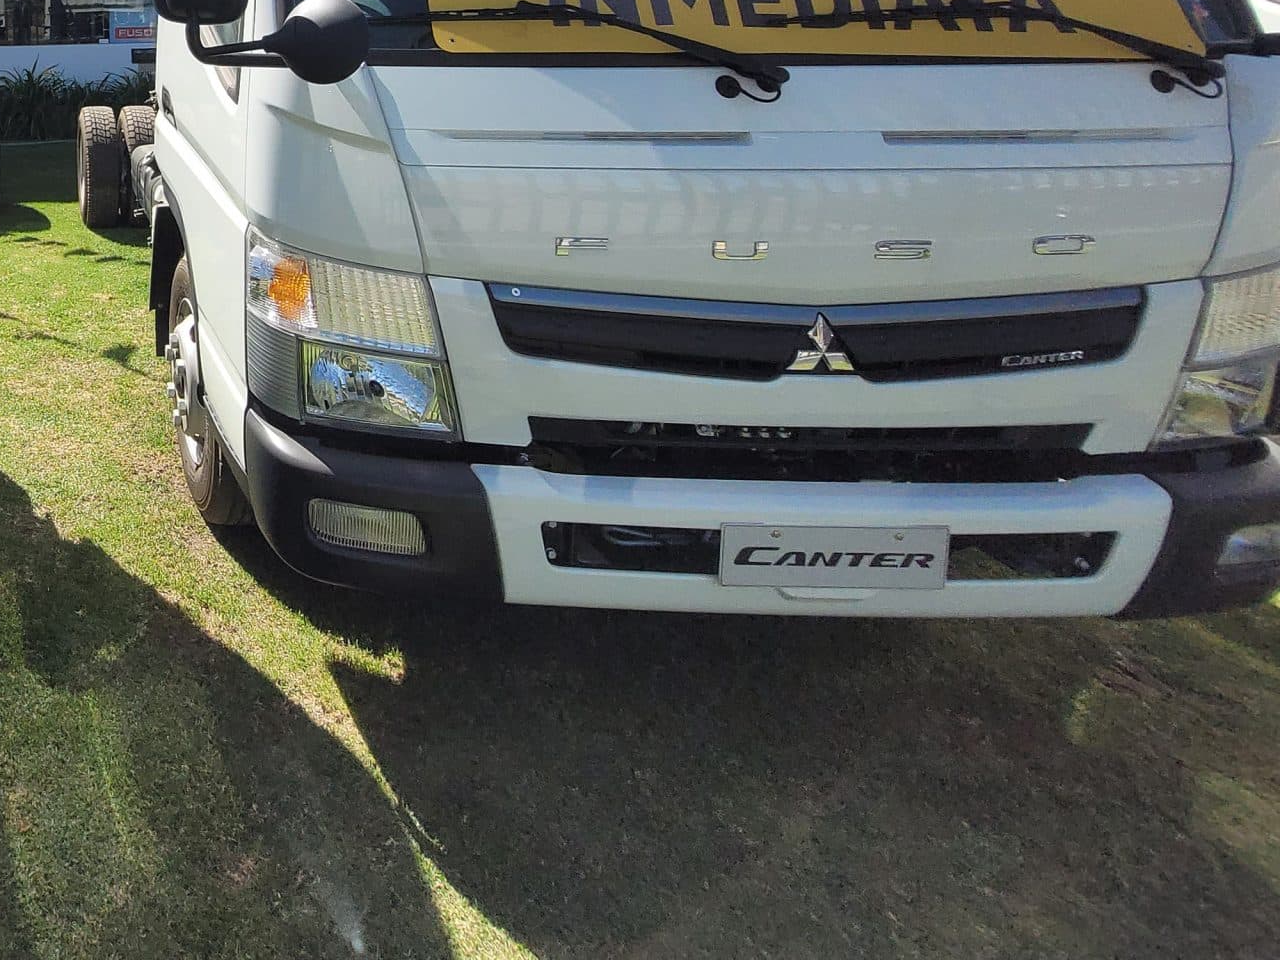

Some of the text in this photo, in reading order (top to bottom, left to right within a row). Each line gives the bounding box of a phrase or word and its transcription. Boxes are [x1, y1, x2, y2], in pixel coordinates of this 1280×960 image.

[118, 28, 153, 38] FUSO
[555, 234, 1097, 261] FUSO
[1000, 349, 1085, 367] CANTER
[733, 546, 936, 569] CANTER
